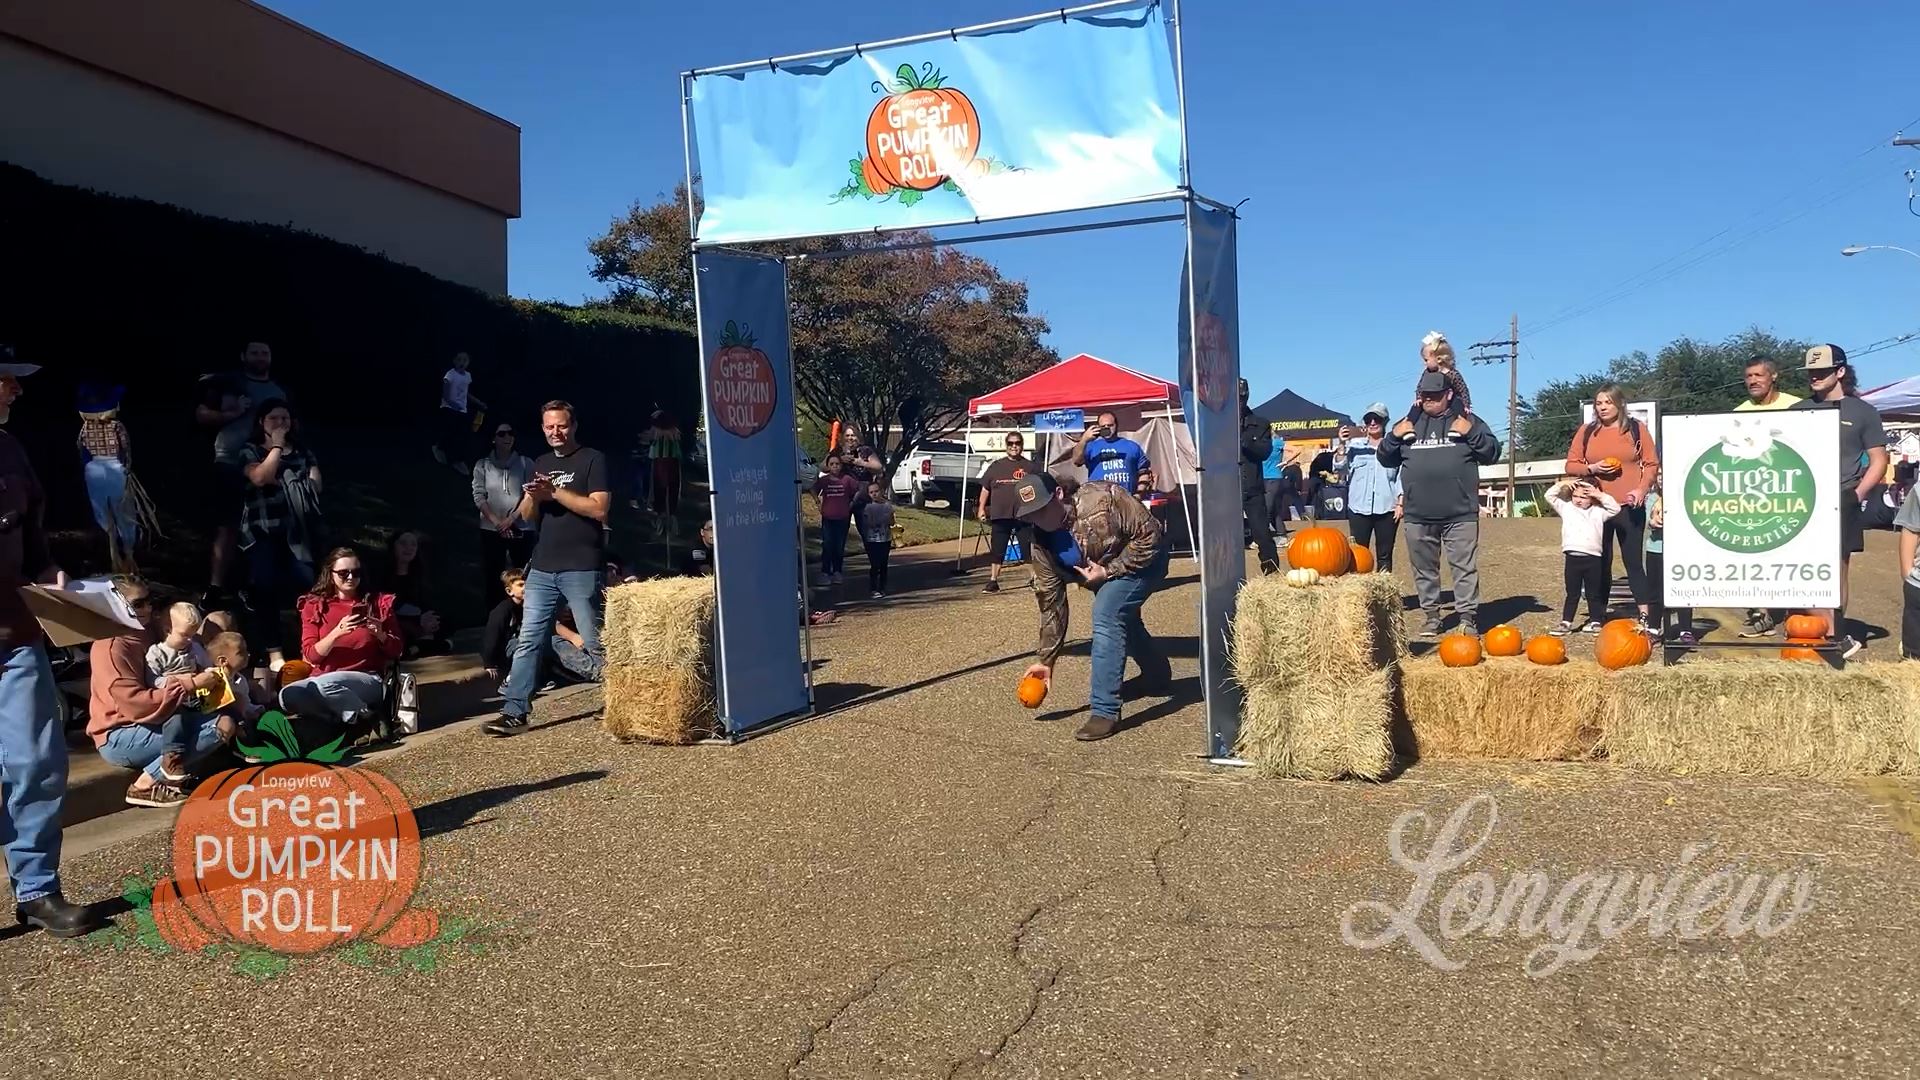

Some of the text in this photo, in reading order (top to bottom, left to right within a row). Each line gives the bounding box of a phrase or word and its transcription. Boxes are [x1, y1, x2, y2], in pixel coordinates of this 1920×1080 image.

[887, 101, 952, 129] Great
[877, 123, 969, 157] PUMPKIN
[720, 356, 759, 379] Great
[714, 381, 769, 403] PUMPKIN
[728, 405, 758, 427] ROLL
[1309, 419, 1339, 429] POLICING
[752, 465, 768, 484] get
[1700, 462, 1802, 506] Sugar
[735, 488, 763, 505] Rolling
[1692, 498, 1808, 515] MAGNOLIA
[736, 511, 749, 526] the
[1699, 516, 1800, 546] PROPERTIES
[1671, 563, 1832, 582] 903.212.7766
[1670, 586, 1833, 600] SugarMagnoliaProperties.com
